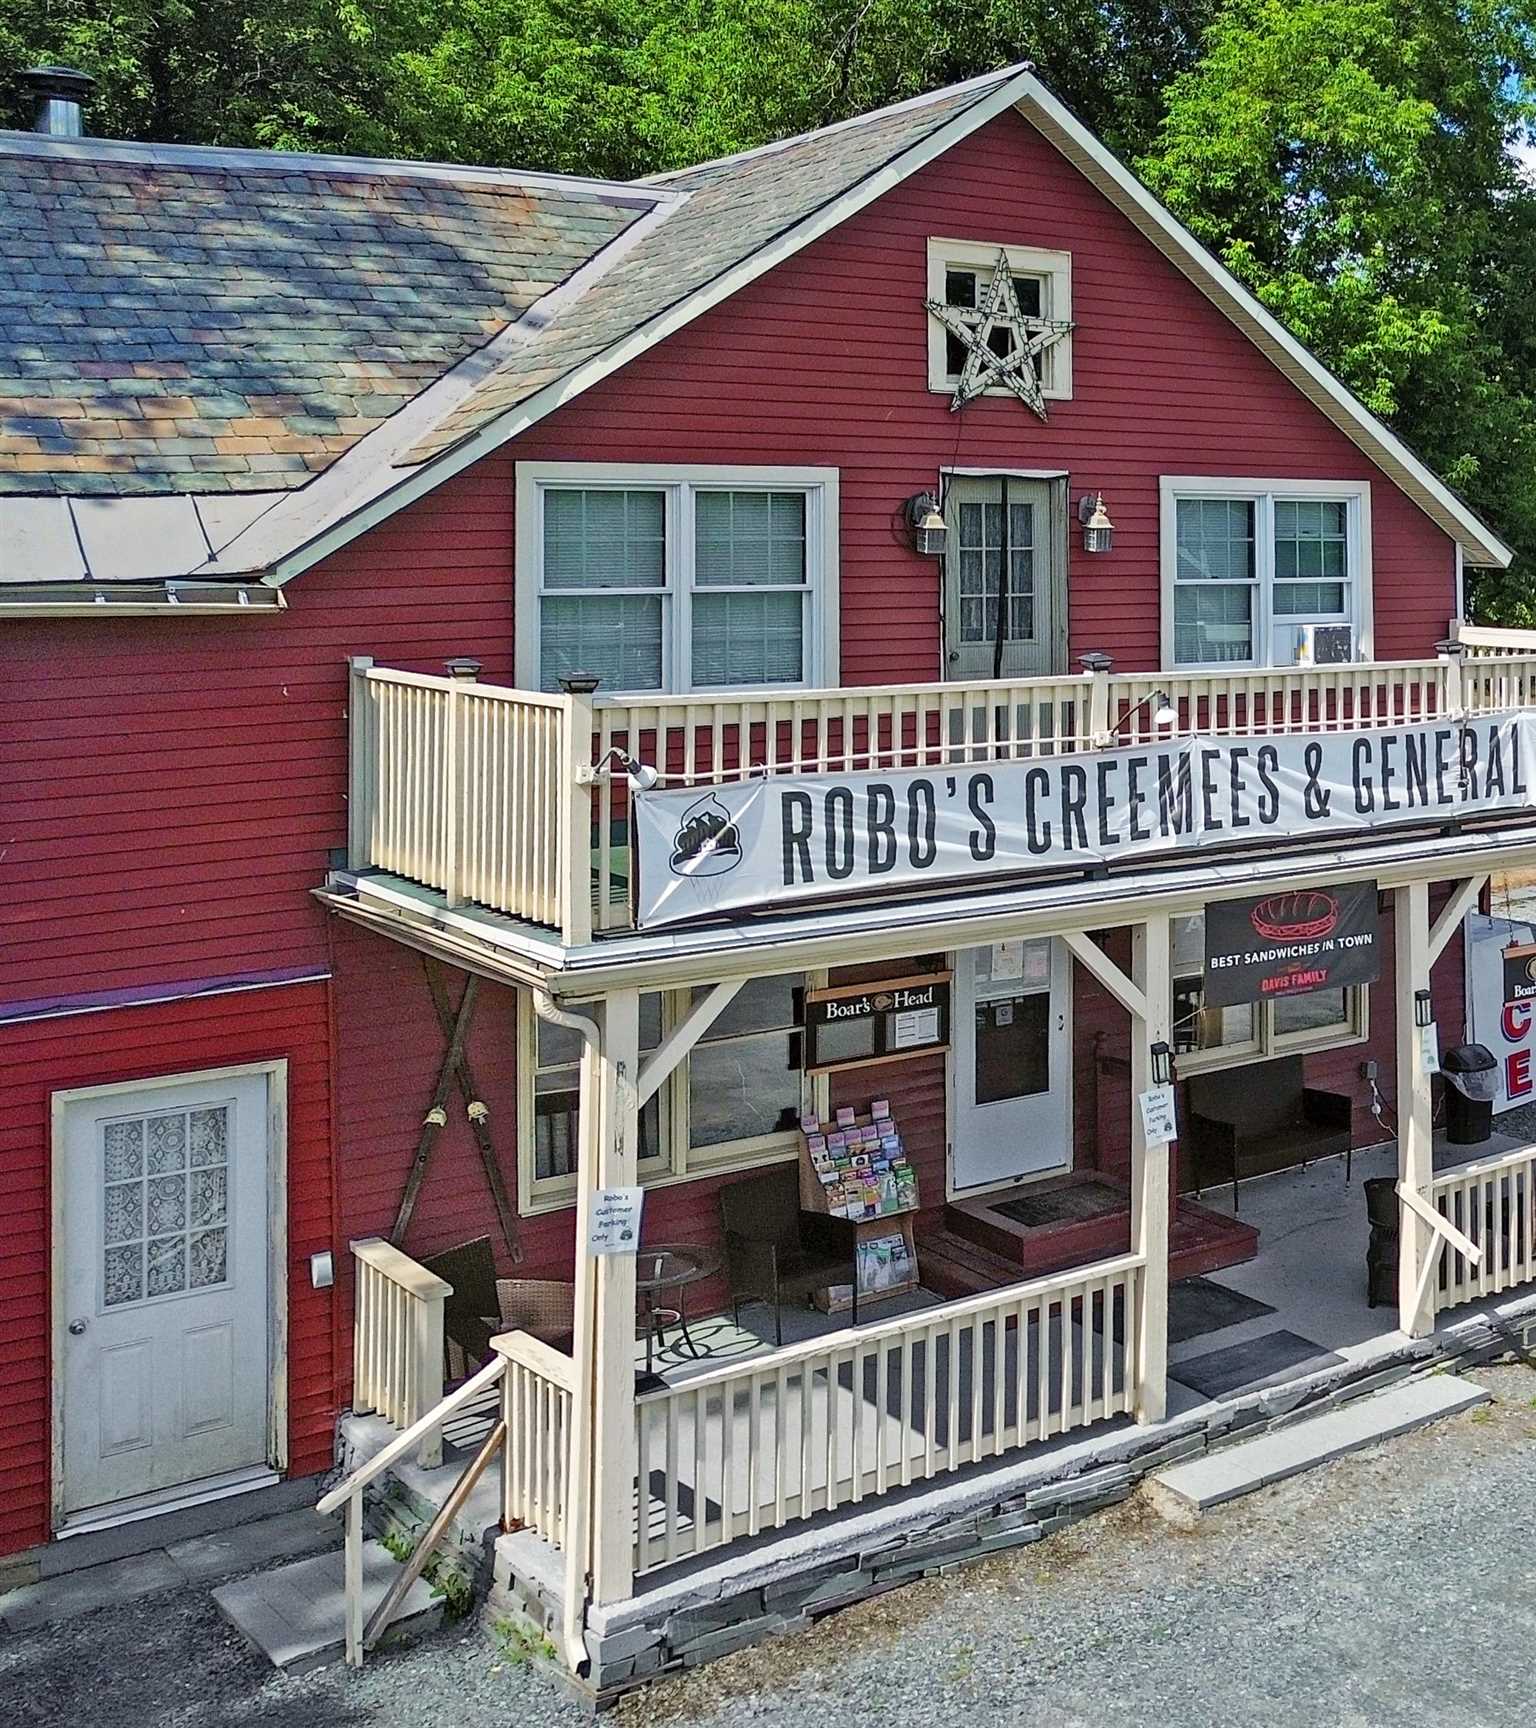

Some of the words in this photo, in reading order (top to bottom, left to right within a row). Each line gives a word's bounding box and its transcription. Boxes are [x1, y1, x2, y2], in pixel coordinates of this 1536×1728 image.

[780, 772, 995, 885] ROBO'S
[1025, 744, 1281, 854] CREEMEES
[1304, 741, 1331, 819] &
[1352, 723, 1528, 815] GENERAL
[1211, 954, 1241, 969] BEST
[1244, 943, 1320, 965] SANDWICHES
[1322, 940, 1334, 952] IN
[1338, 934, 1372, 948] TOWN
[1261, 975, 1290, 992] DAVIS
[1292, 970, 1328, 986] FAMILY
[826, 997, 871, 1019] Boar's
[894, 986, 934, 1008] Head
[1500, 1002, 1534, 1100] CE
